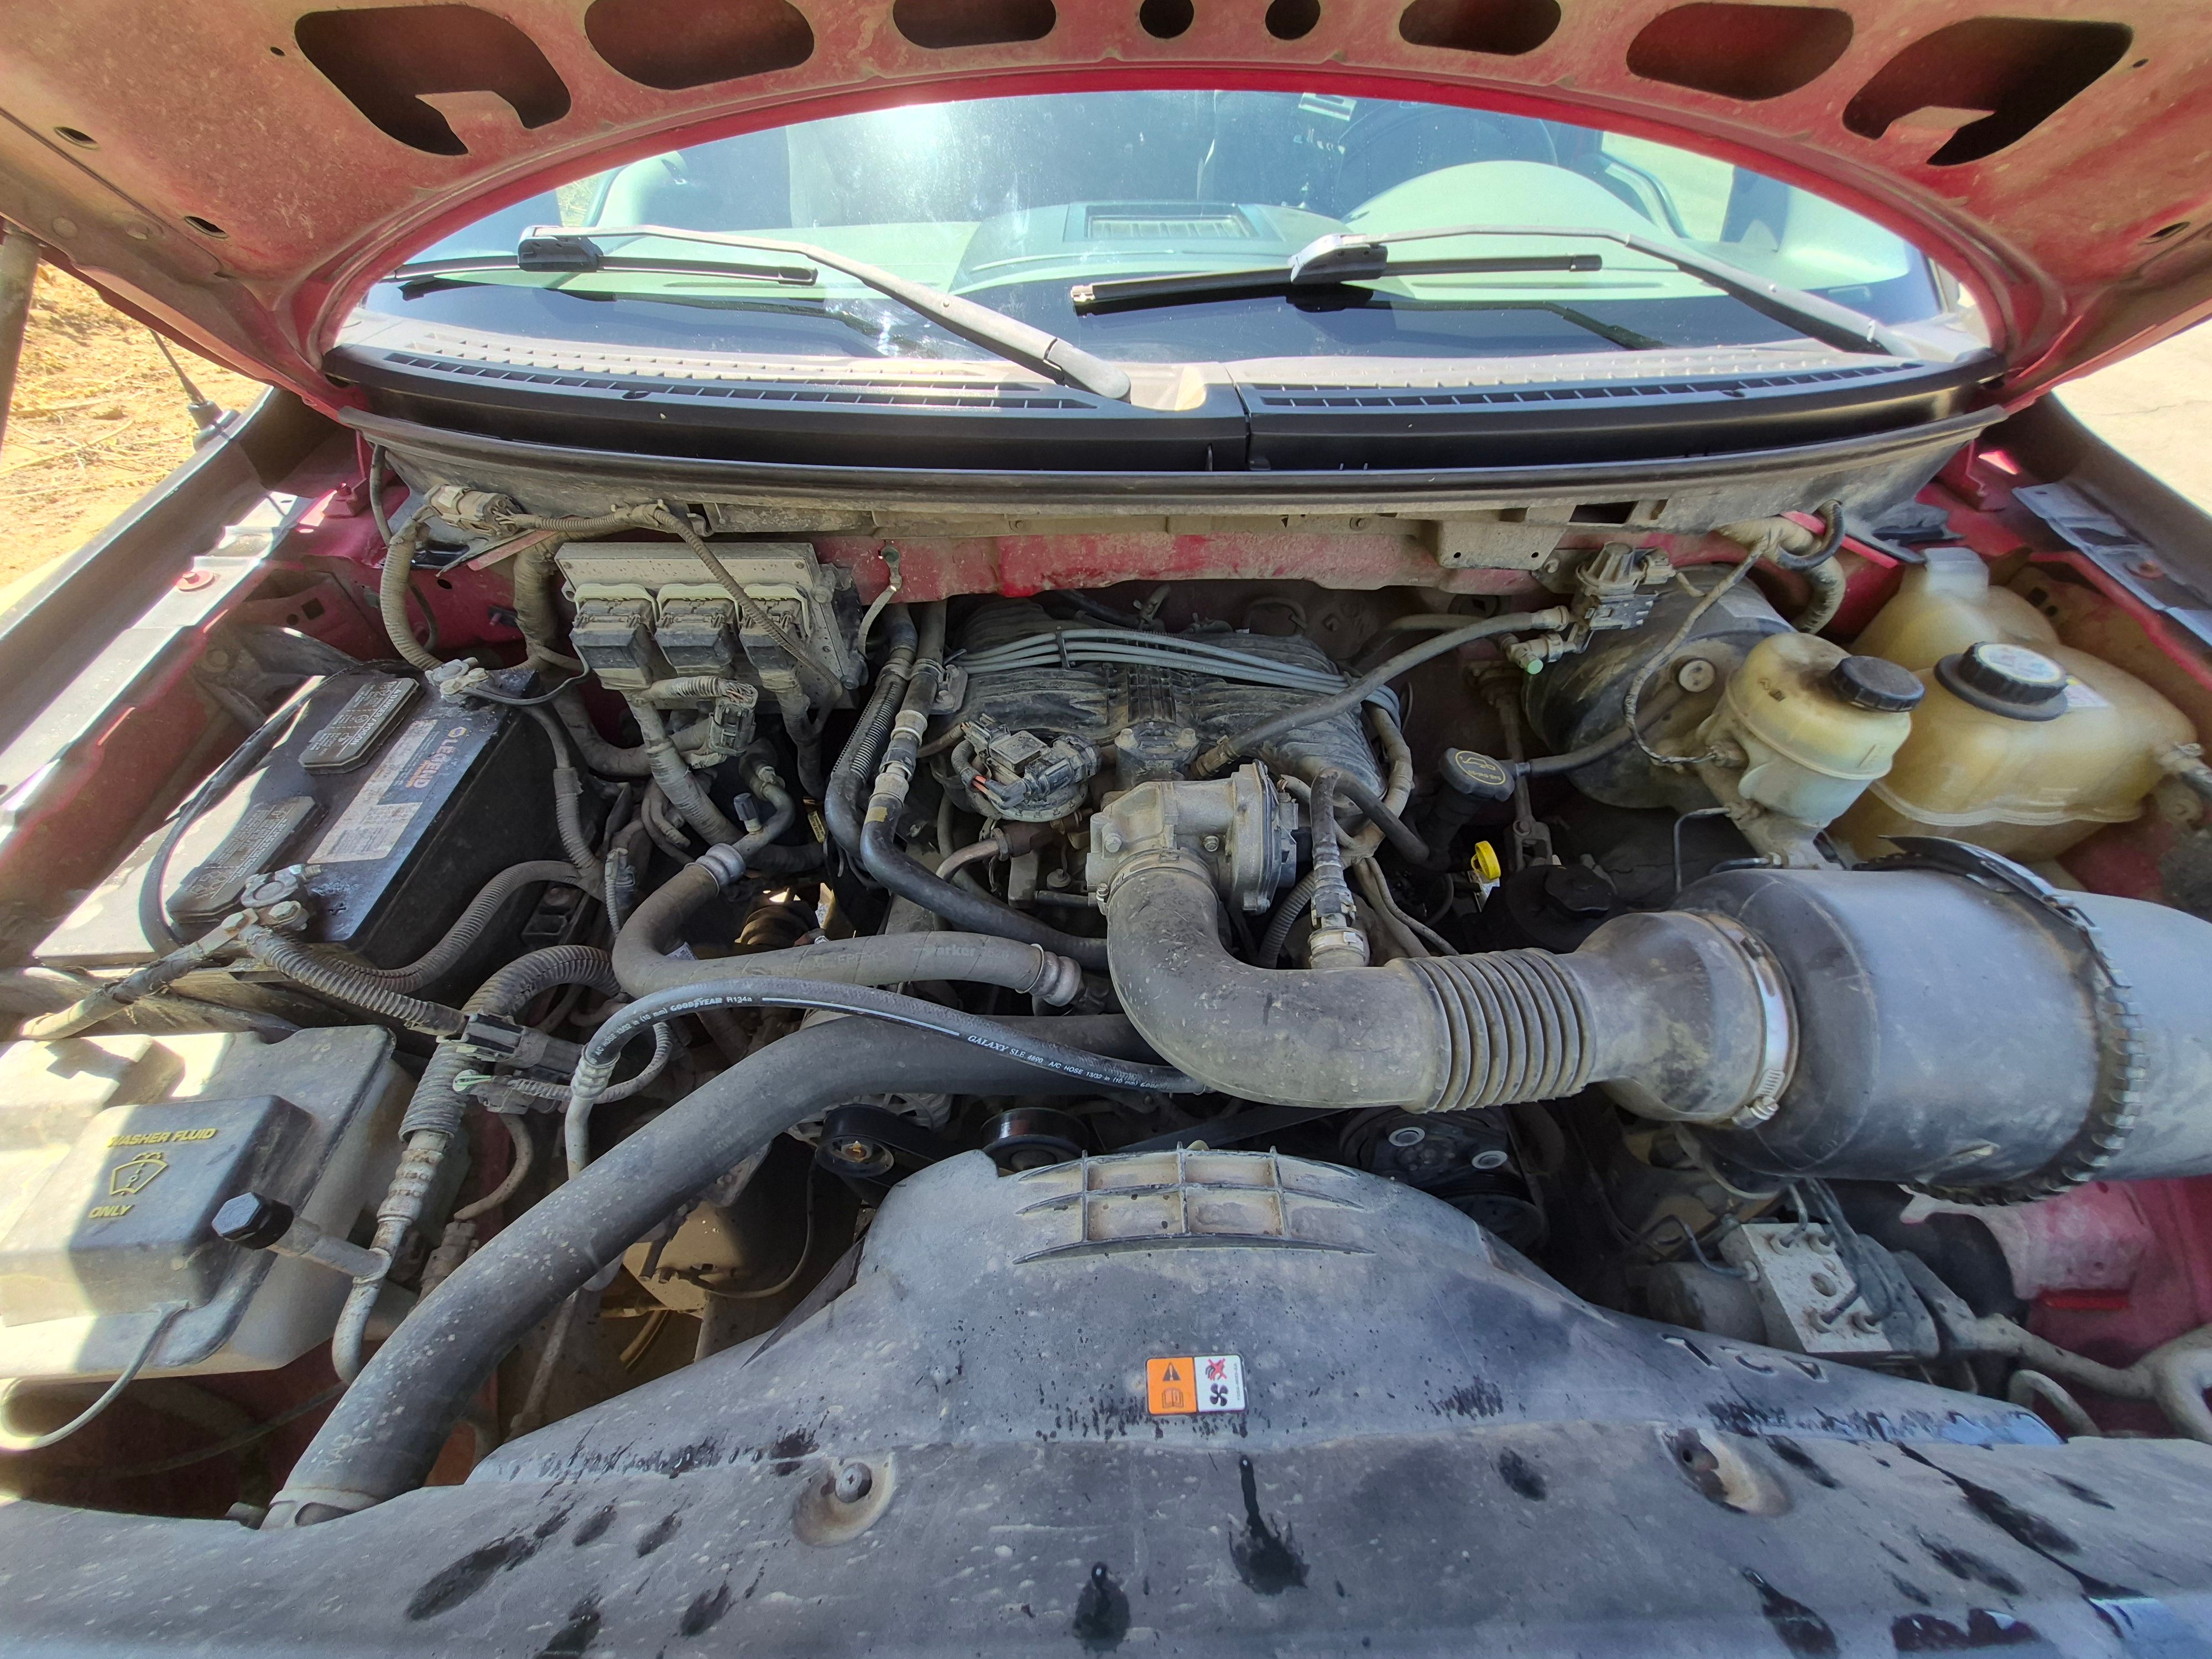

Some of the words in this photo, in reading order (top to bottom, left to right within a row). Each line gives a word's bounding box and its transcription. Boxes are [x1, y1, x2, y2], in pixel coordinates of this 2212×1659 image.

[349, 722, 375, 745] POISON
[414, 738, 458, 789] LEGEND
[602, 1032, 618, 1046] HOSE
[670, 997, 723, 1012] GOODYEAR
[967, 1035, 1009, 1052] GALAXY
[1009, 1048, 1026, 1058] SLE
[1027, 1055, 1044, 1063] 4890
[1063, 1065, 1083, 1075] HOSE
[1086, 1071, 1103, 1080] 13/32
[108, 1132, 172, 1147] WASHER
[173, 1128, 218, 1142] FLUID
[89, 1205, 133, 1218] ONLY
